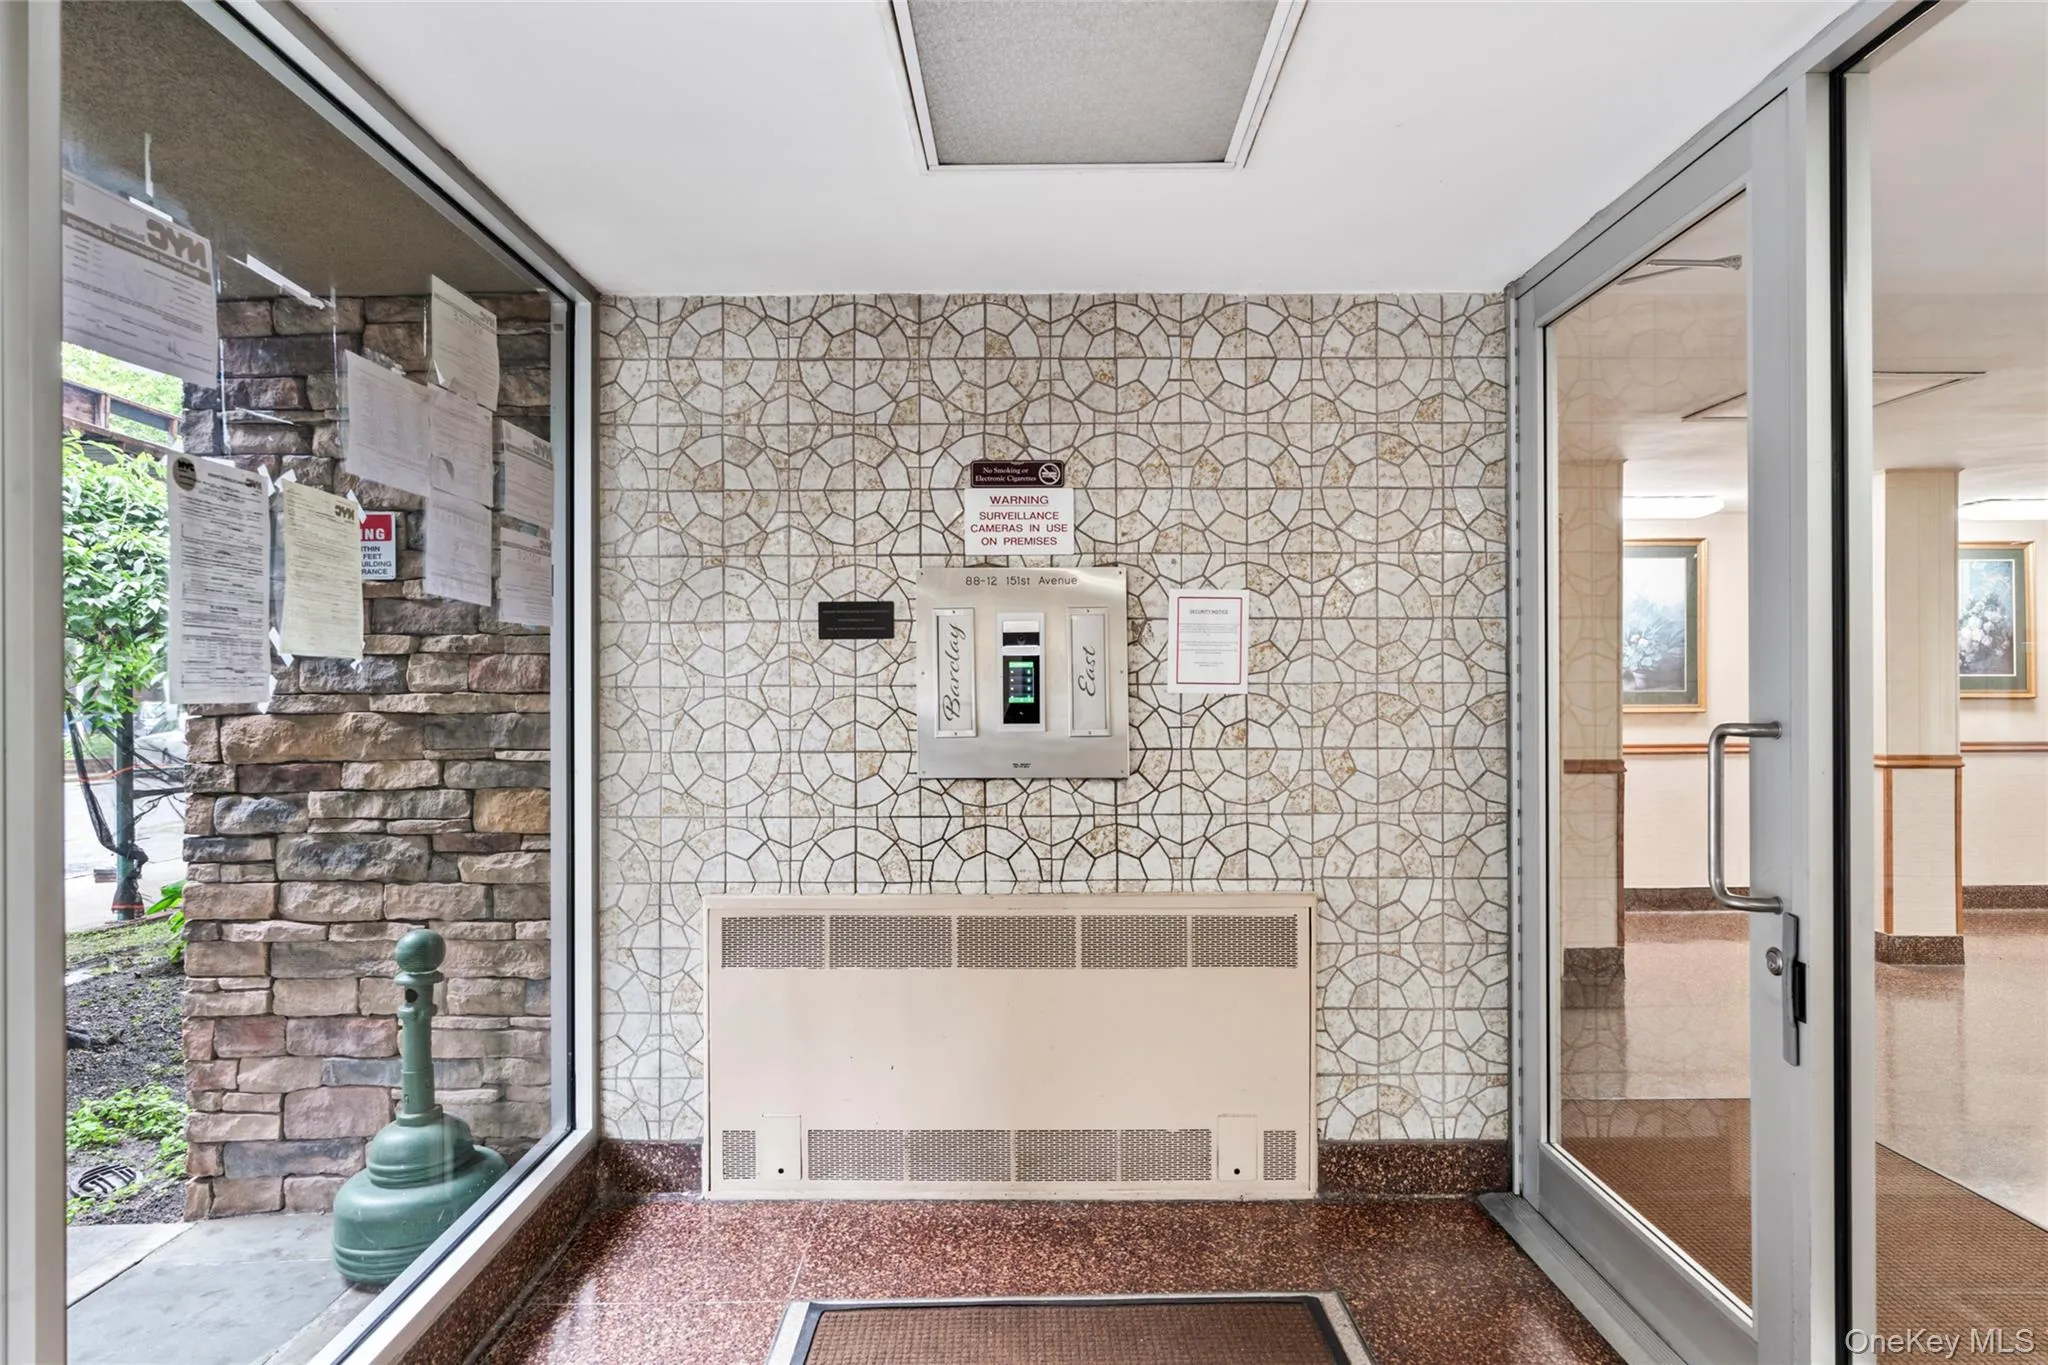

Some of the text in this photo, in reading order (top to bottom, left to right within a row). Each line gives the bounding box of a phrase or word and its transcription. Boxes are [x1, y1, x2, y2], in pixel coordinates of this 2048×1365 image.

[994, 467, 1020, 475] Smoking
[989, 495, 1049, 505] WARNING
[979, 511, 1060, 520] SURVEILLANCE
[970, 523, 1068, 533] CAMERAS IN USE
[360, 528, 385, 540] ING
[981, 537, 1058, 546] ON PREMISES
[965, 576, 1078, 586] 88-12 151st Avenue
[942, 623, 967, 721] Barclay
[1077, 646, 1096, 697] East
